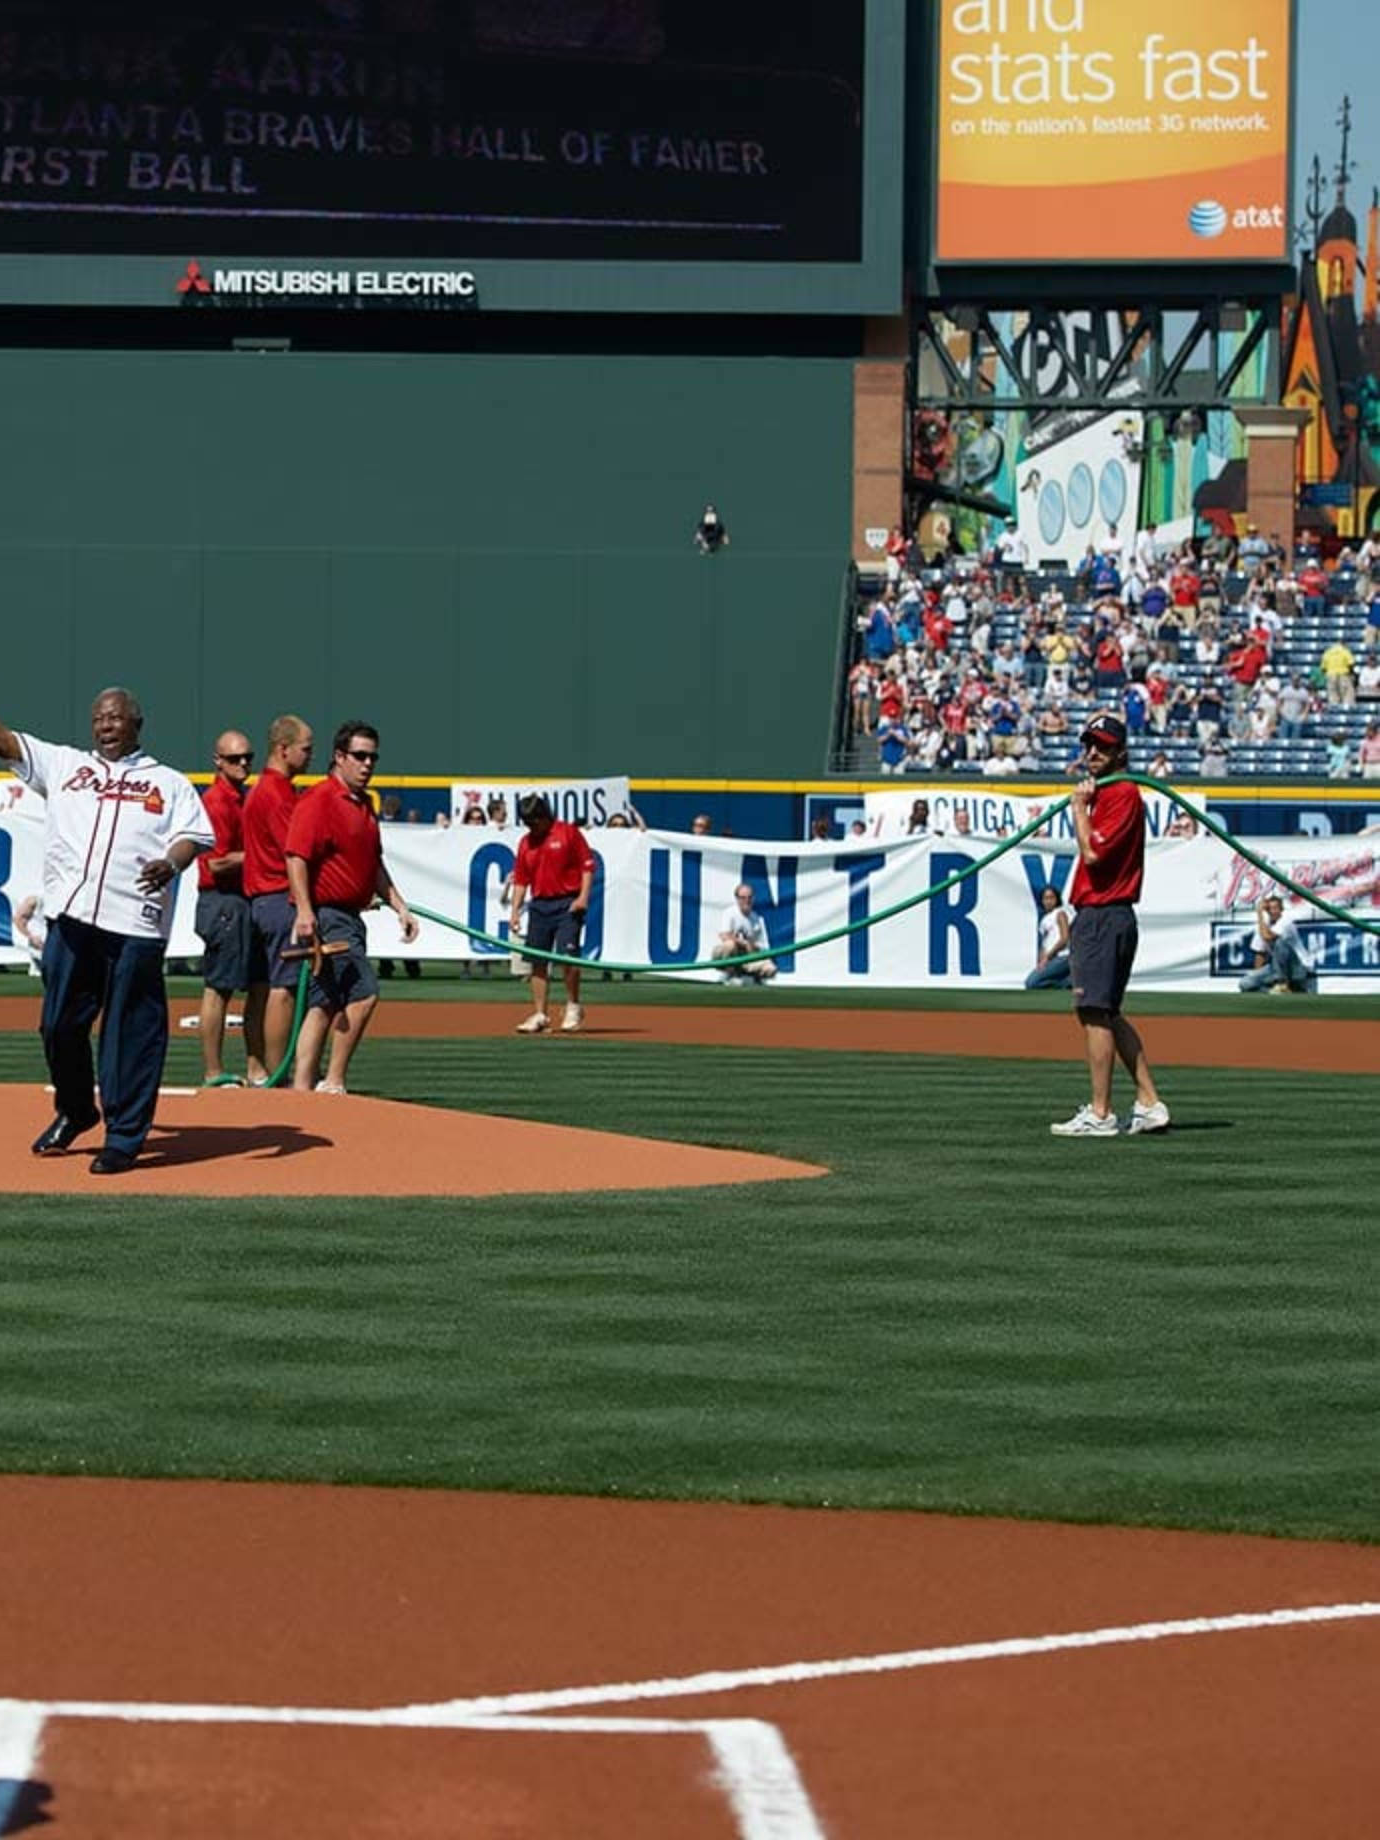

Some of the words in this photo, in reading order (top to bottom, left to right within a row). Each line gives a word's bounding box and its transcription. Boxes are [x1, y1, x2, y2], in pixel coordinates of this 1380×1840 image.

[950, 41, 1116, 104] stats
[1138, 34, 1269, 102] fast
[950, 119, 974, 136] on
[981, 116, 1009, 135] the
[1016, 115, 1087, 134] nation's
[1092, 112, 1151, 133] fastest
[1159, 114, 1184, 133] 3G
[1190, 113, 1270, 132] network.
[222, 107, 414, 157] BRAVES
[432, 123, 546, 164] HALL
[559, 129, 612, 166] OF
[630, 133, 769, 176] FAMER
[126, 152, 258, 195] BALL
[1232, 204, 1284, 229] at&t
[214, 270, 350, 294] MITSUBISHI
[356, 271, 475, 295] ELECTRIC
